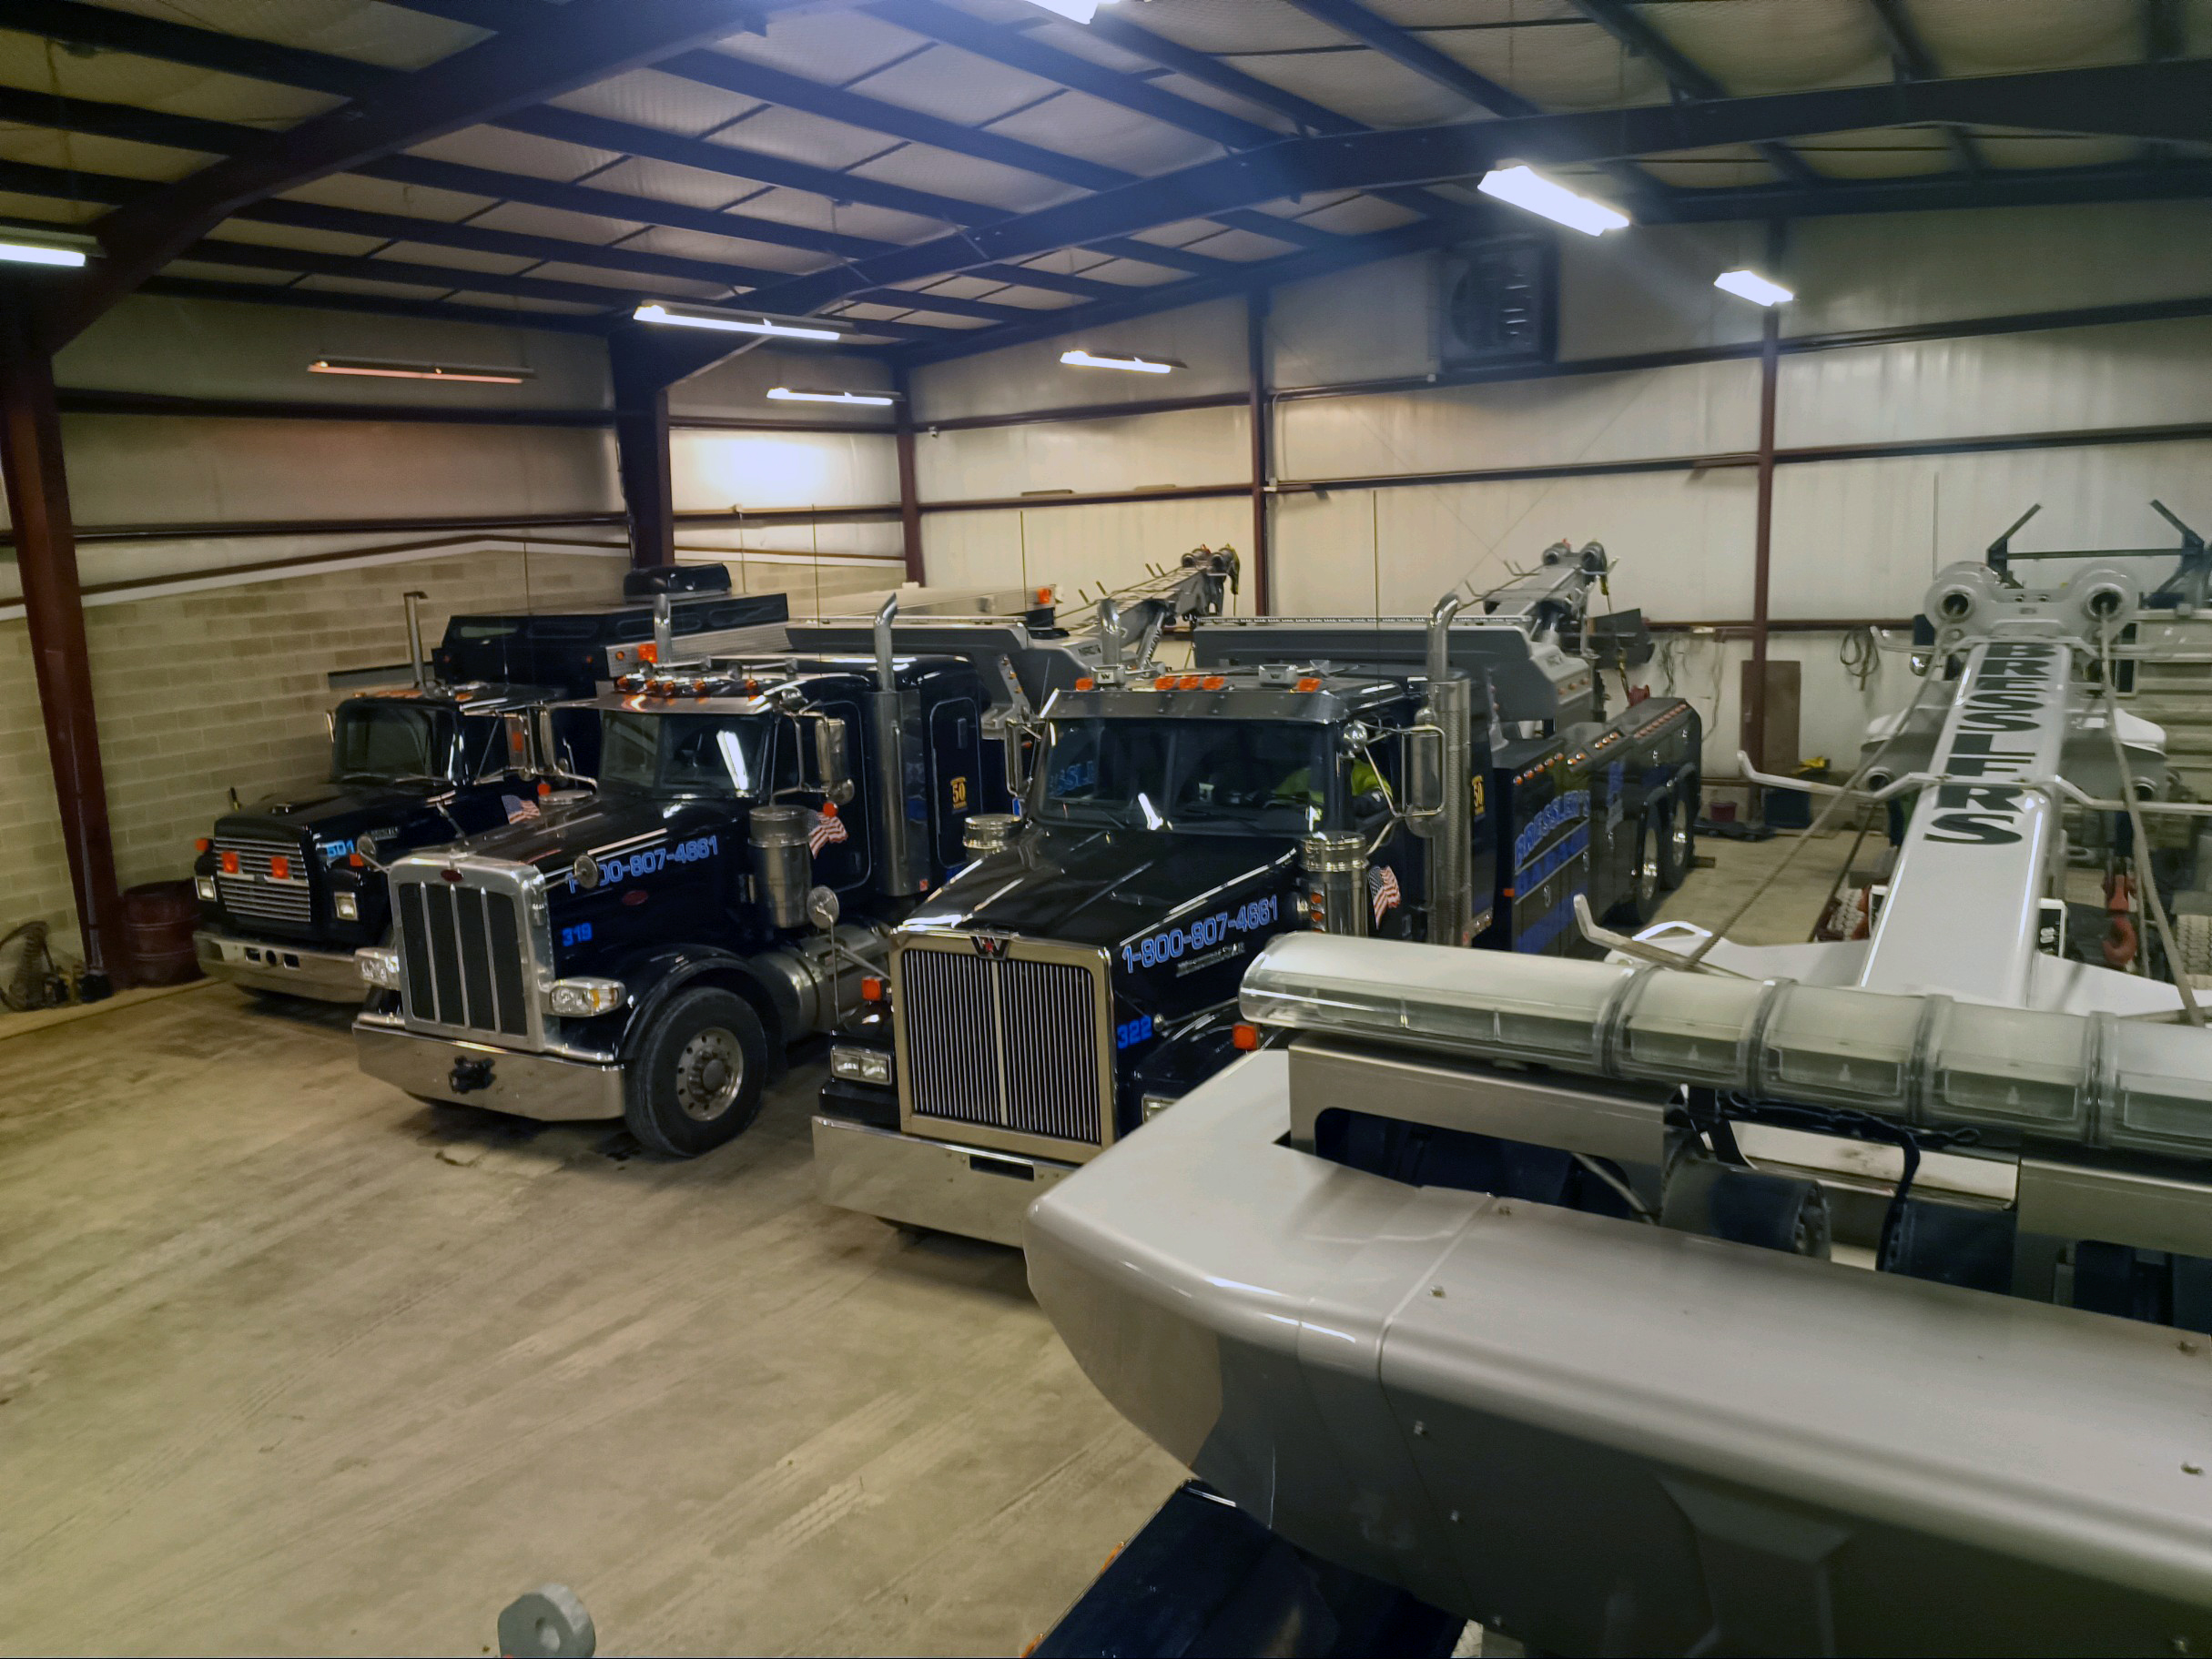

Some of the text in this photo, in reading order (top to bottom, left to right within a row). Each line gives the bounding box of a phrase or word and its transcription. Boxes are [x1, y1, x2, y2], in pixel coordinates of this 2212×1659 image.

[565, 835, 718, 895] 1-00-807-4661
[562, 922, 593, 947] 319
[1116, 1015, 1153, 1049] 322
